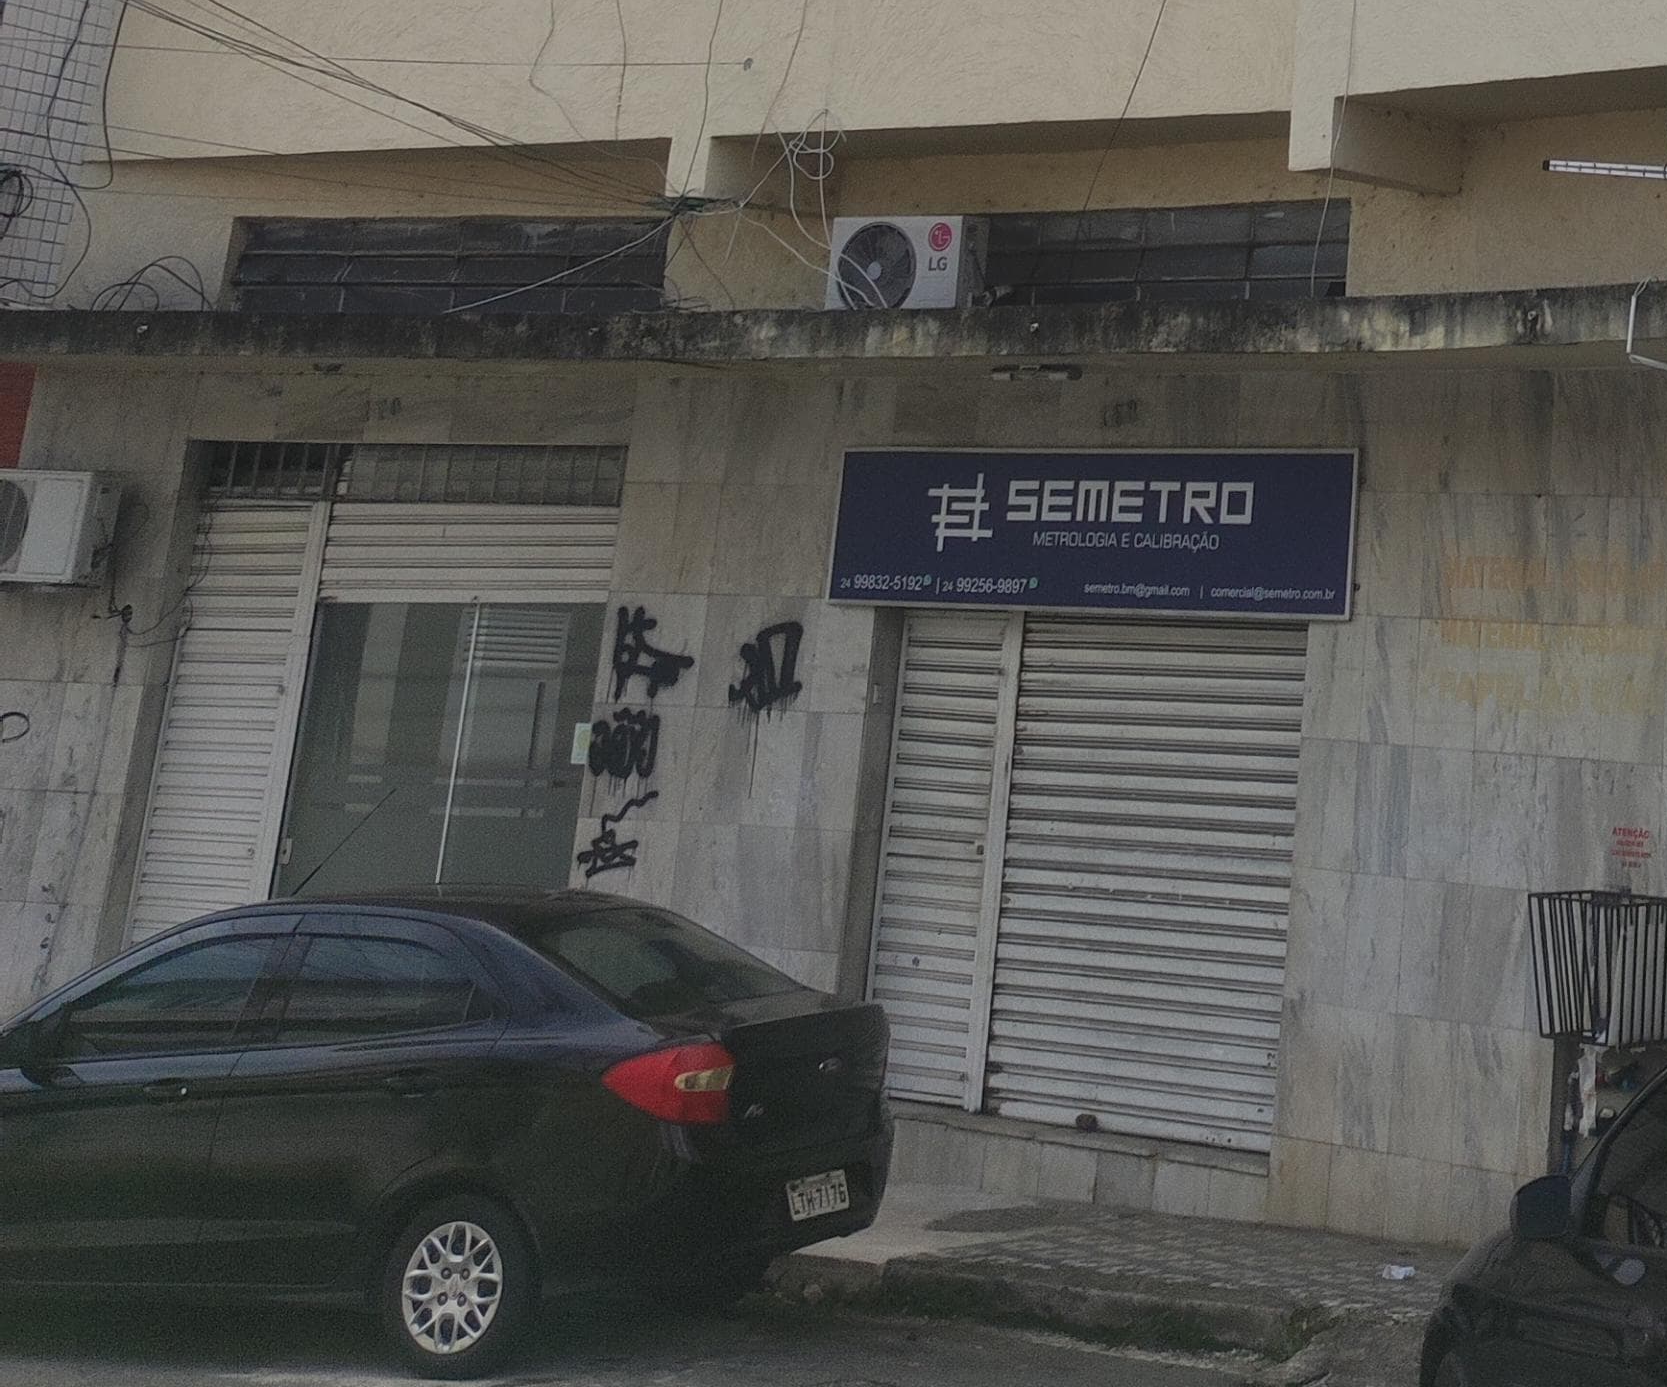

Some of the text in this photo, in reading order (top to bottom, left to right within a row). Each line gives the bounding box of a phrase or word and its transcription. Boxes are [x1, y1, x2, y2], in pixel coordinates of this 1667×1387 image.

[927, 256, 948, 272] LG
[1006, 480, 1254, 525] SEMETRO
[1033, 530, 1220, 554] METROLOGIA E CALIBRAÇÃO
[840, 578, 851, 589] 24
[853, 574, 923, 591] 99832-5192
[1210, 586, 1336, 602] comercial@semetro.com.br
[1612, 826, 1650, 840] ATENÇÃO
